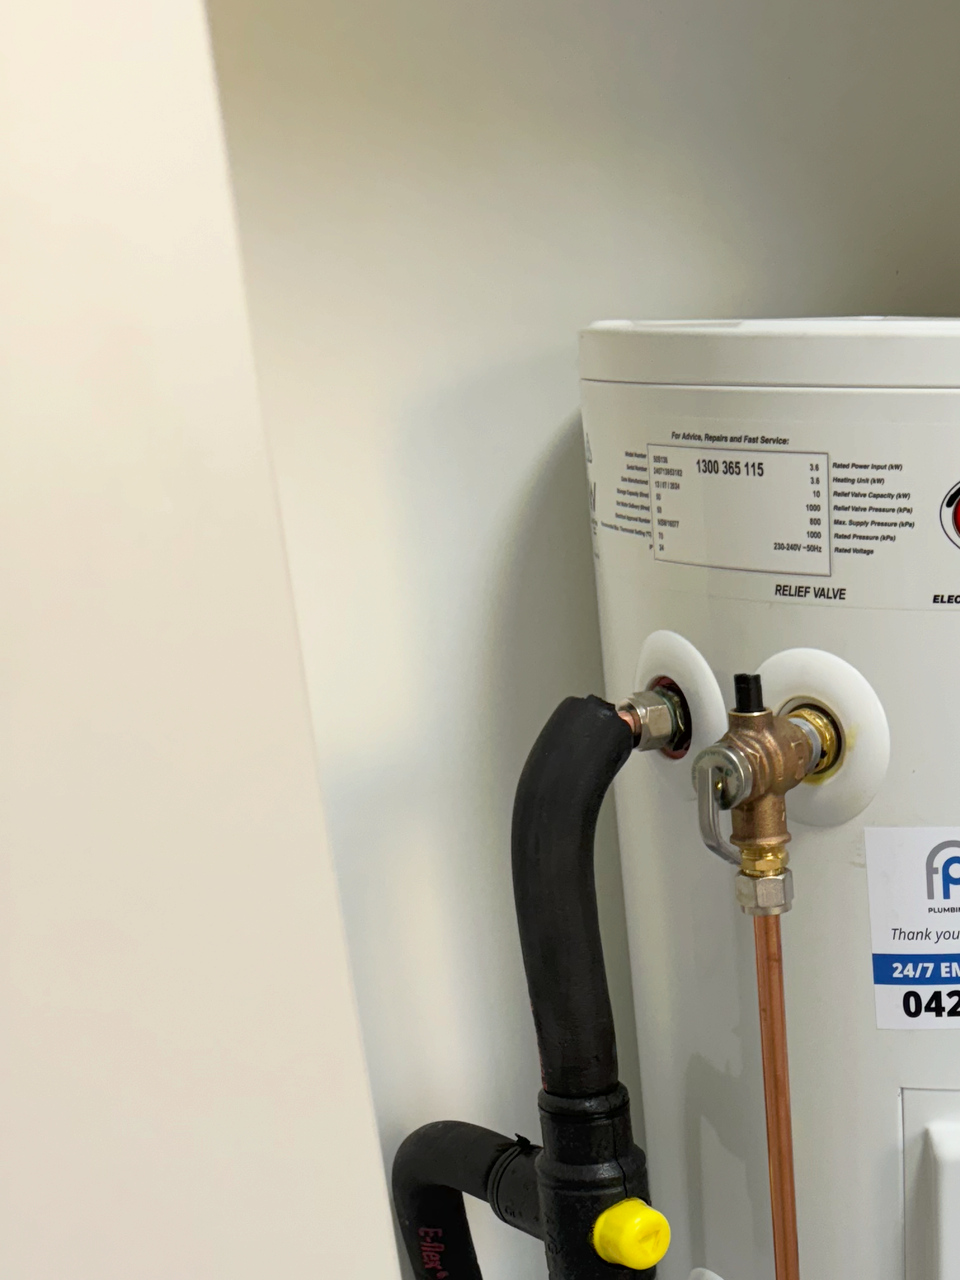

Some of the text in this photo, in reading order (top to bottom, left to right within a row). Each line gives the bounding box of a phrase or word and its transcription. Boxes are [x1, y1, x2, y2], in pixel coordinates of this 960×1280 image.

[672, 432, 790, 445] For Advice, Repairs and Fast Service:
[696, 459, 719, 475] 1300
[722, 461, 741, 476] 365
[744, 462, 764, 477] 115
[810, 464, 819, 472] 3.6
[811, 477, 820, 485] 3.6
[833, 477, 855, 485] Heating
[868, 492, 895, 500] Capacity
[896, 492, 910, 500] (kW)
[806, 504, 821, 512] 1000
[807, 531, 821, 539] 1000
[775, 584, 846, 600] RELIEF VALVE
[891, 928, 931, 941] Thank
[936, 928, 960, 944] you
[892, 963, 935, 978] 24/7
